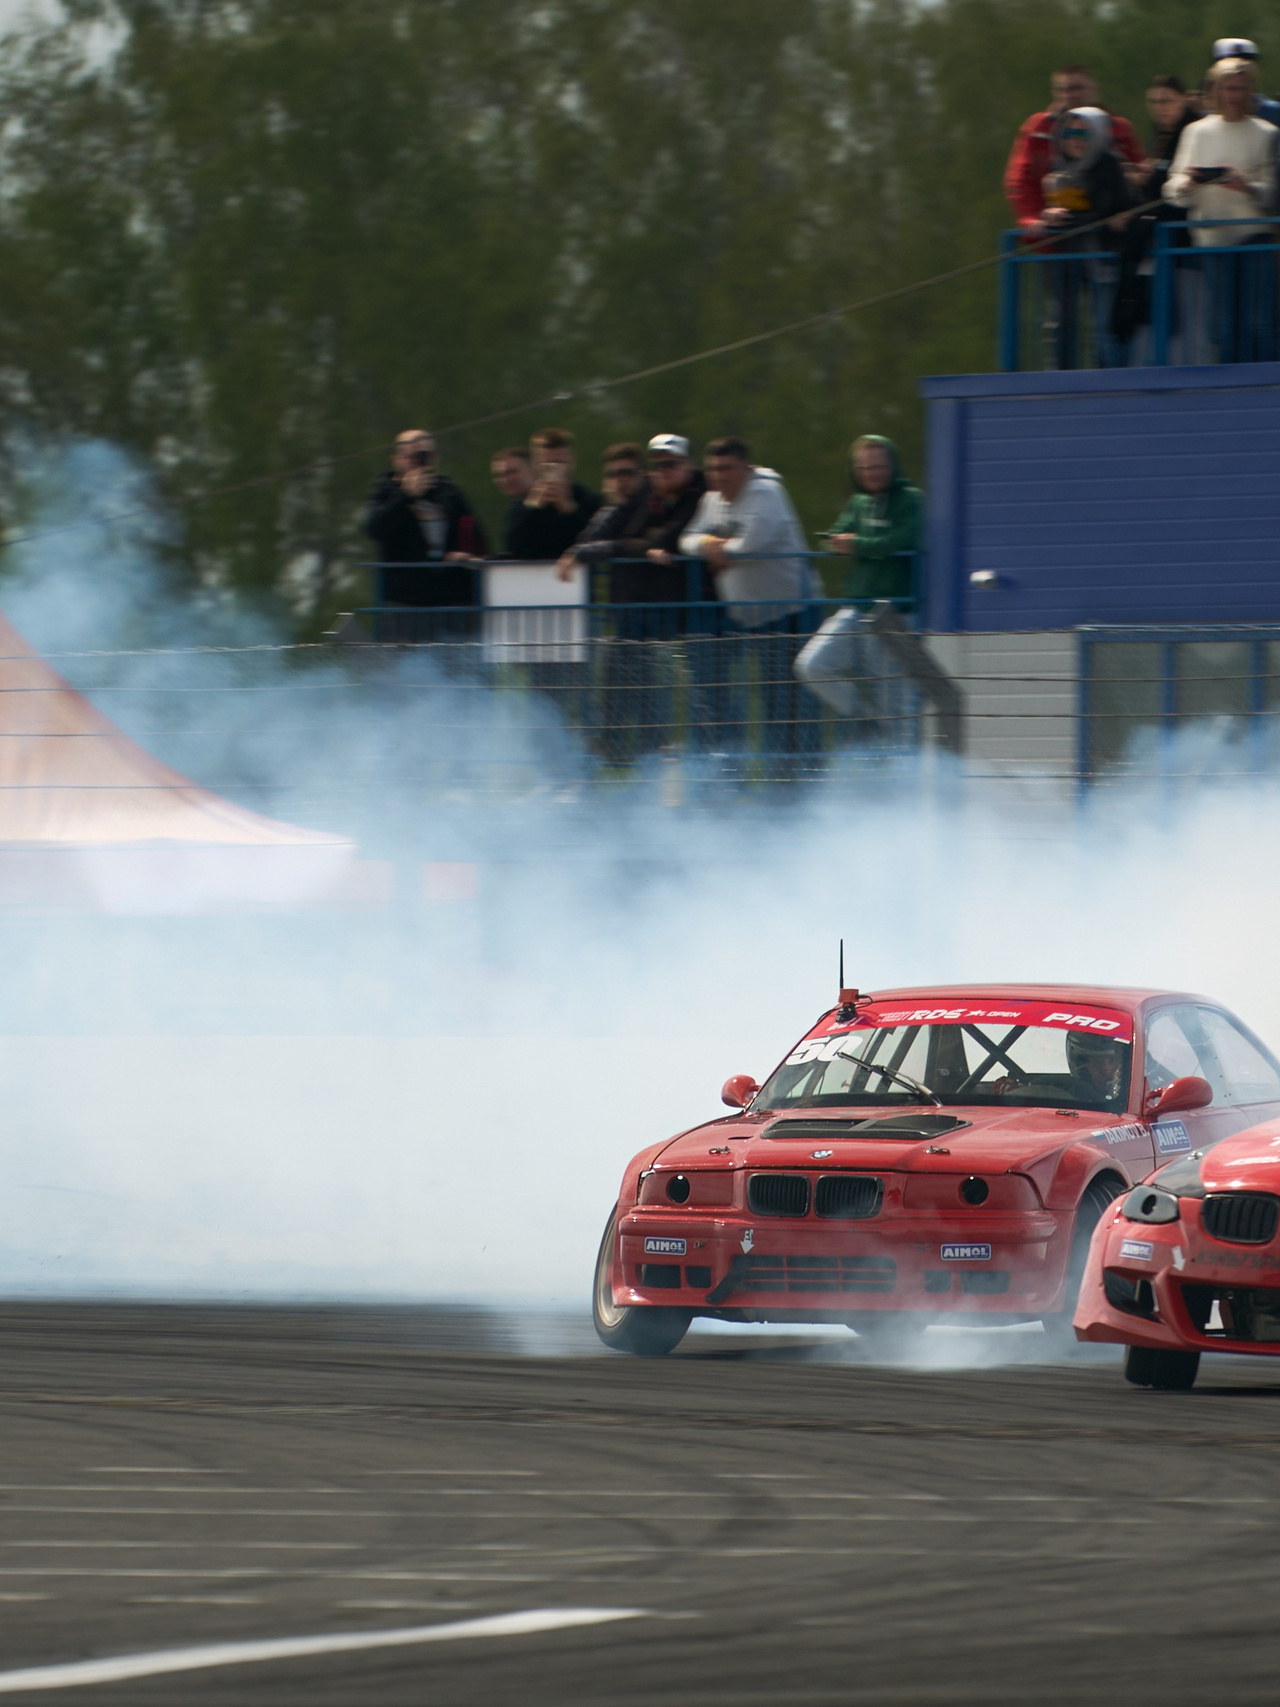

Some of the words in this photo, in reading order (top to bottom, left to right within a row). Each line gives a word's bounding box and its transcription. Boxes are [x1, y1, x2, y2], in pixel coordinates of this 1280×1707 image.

[907, 1009, 967, 1020] RDS
[1042, 1012, 1120, 1031] PRO
[785, 1035, 864, 1065] 50
[1155, 1126, 1189, 1146] AIMOL
[646, 1240, 684, 1252] AIMOL
[943, 1247, 989, 1258] AIMOL
